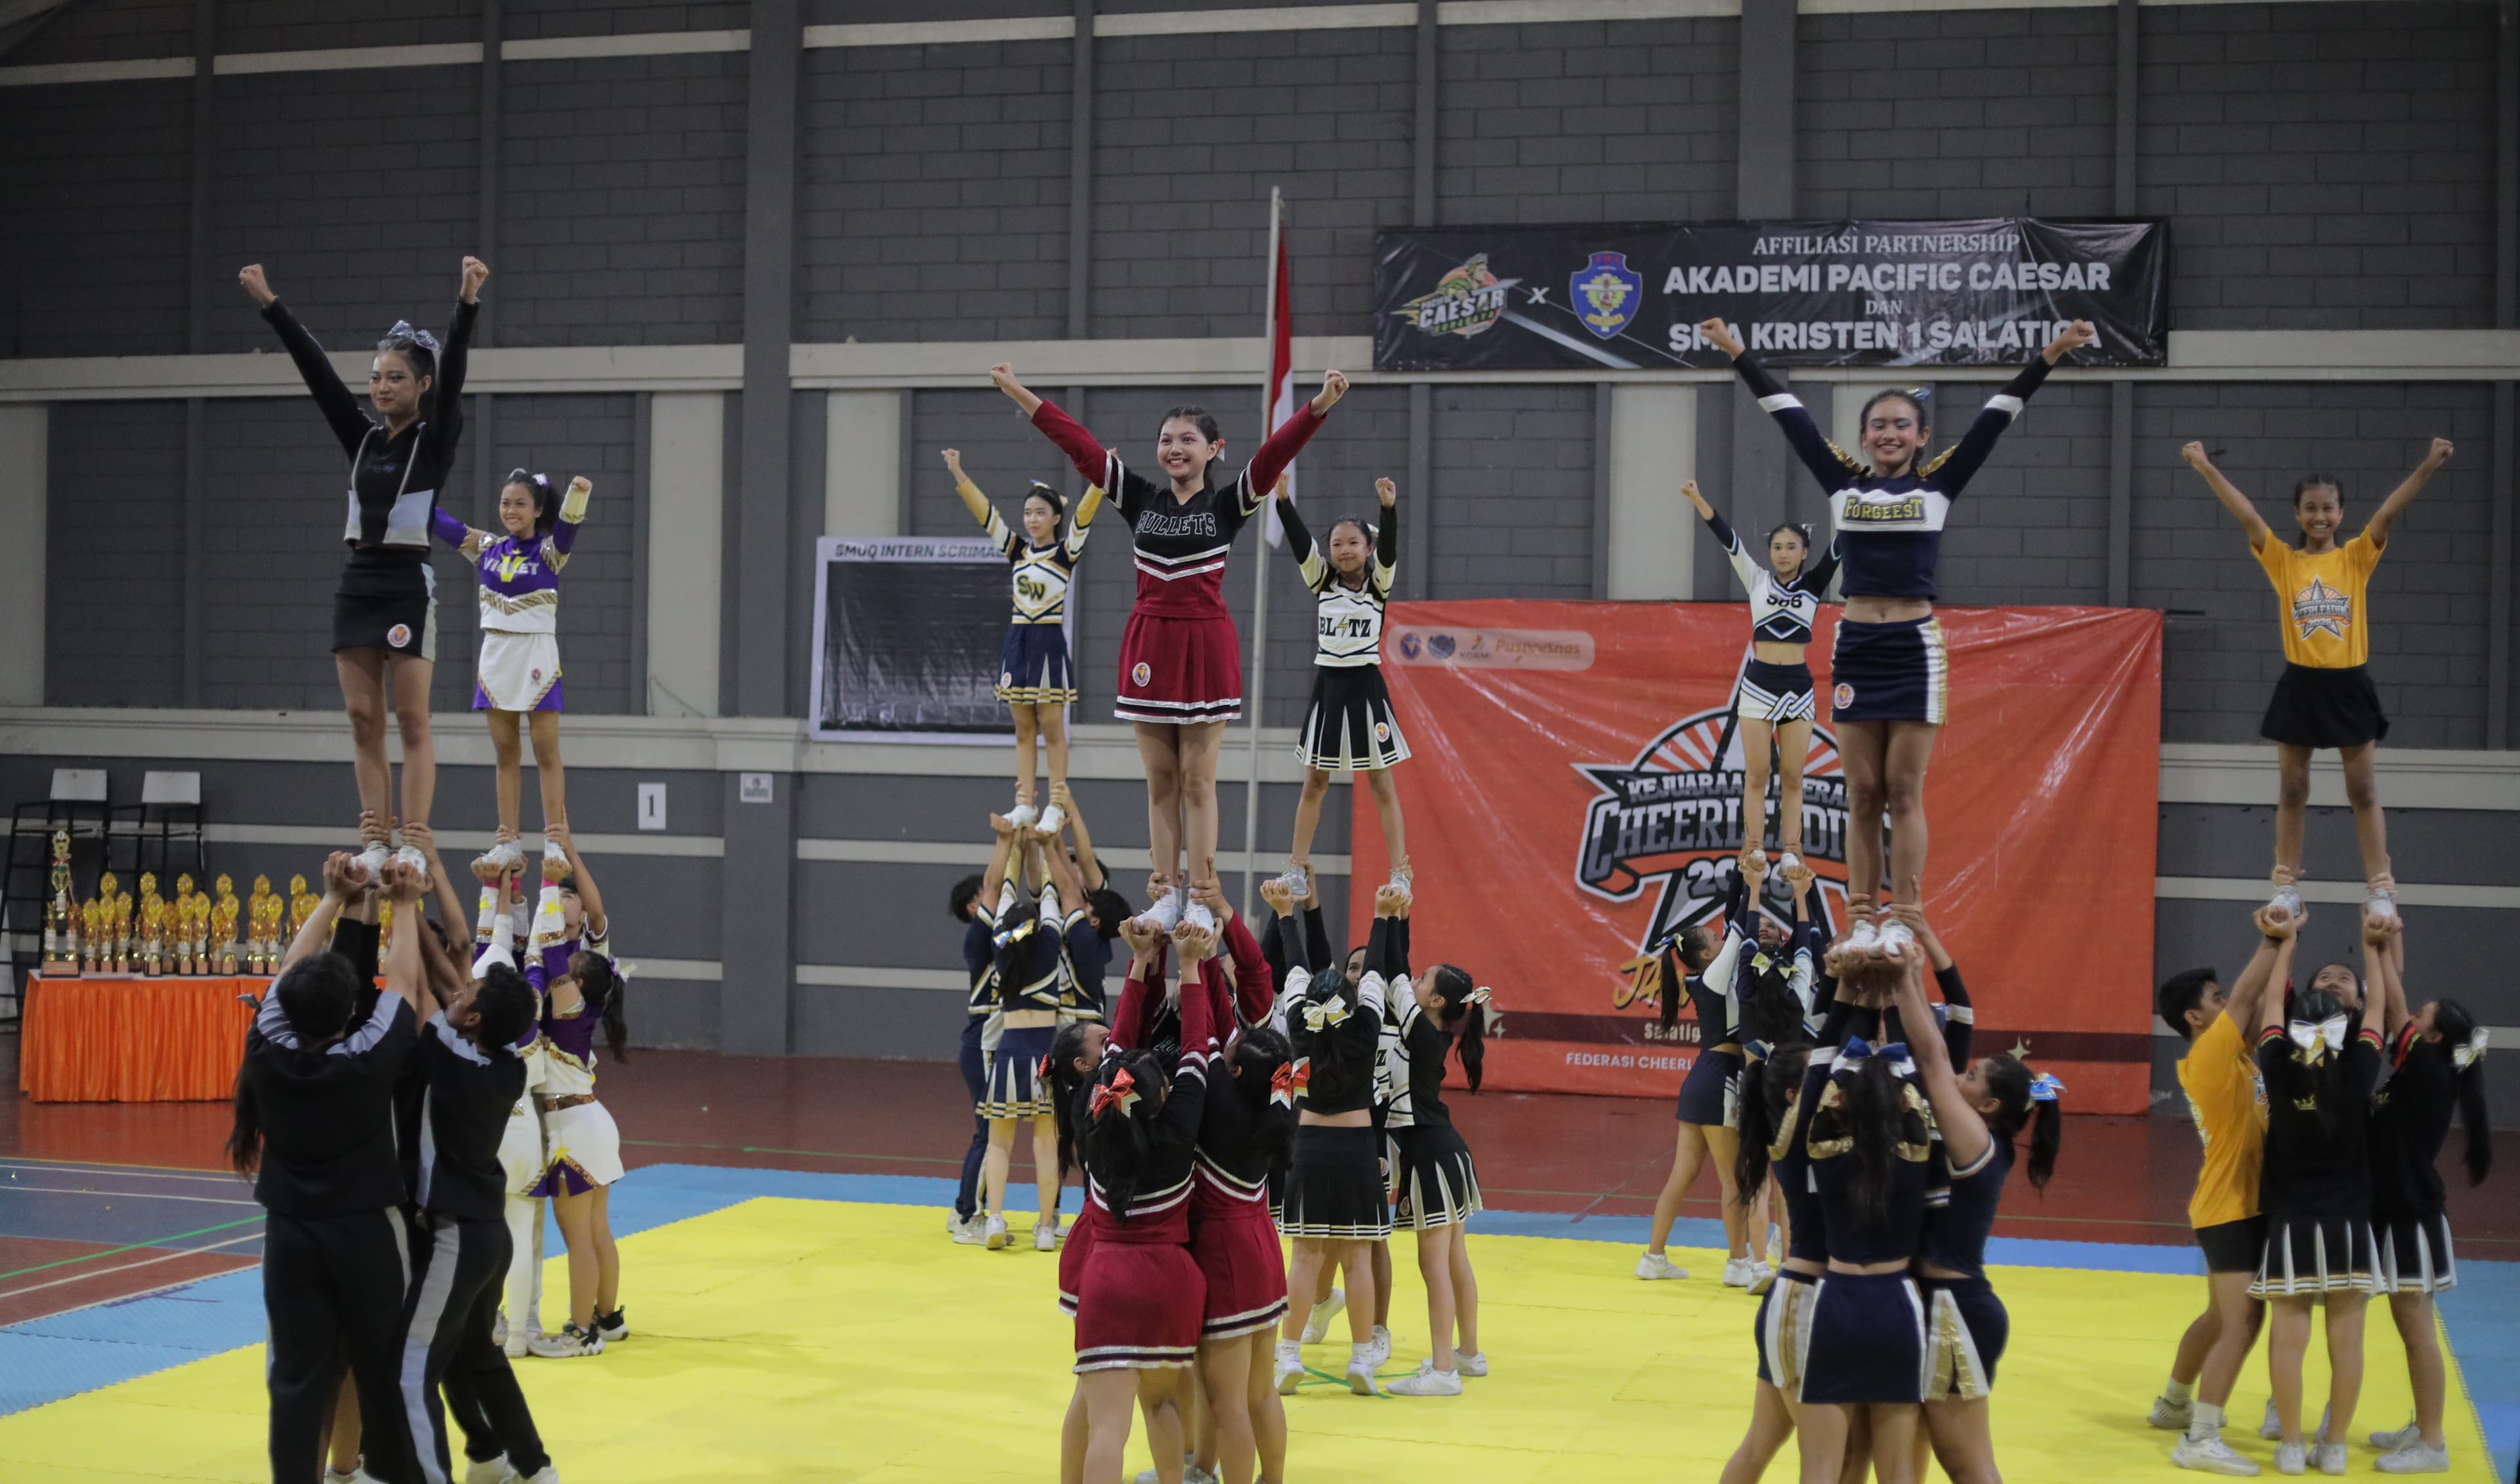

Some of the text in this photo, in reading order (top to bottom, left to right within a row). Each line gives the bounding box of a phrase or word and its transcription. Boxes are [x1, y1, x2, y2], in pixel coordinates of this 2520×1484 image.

[1752, 233, 2021, 255] AFFILIASI PARTNERSHIP
[1663, 262, 2110, 294] AKADEMI PACIFIC CAESAR
[1419, 289, 1504, 329] CAESAR
[1865, 300, 1903, 316] DAN
[1751, 320, 1899, 350] KRISTEN
[1905, 320, 1922, 349] 1
[1845, 496, 1923, 519] FORGEEST
[881, 544, 934, 557] INTERN
[1017, 574, 1045, 601] SW
[1628, 772, 1770, 803] KEJUARAA
[647, 794, 655, 817] 1
[1566, 1051, 1635, 1067] FEDERASI
